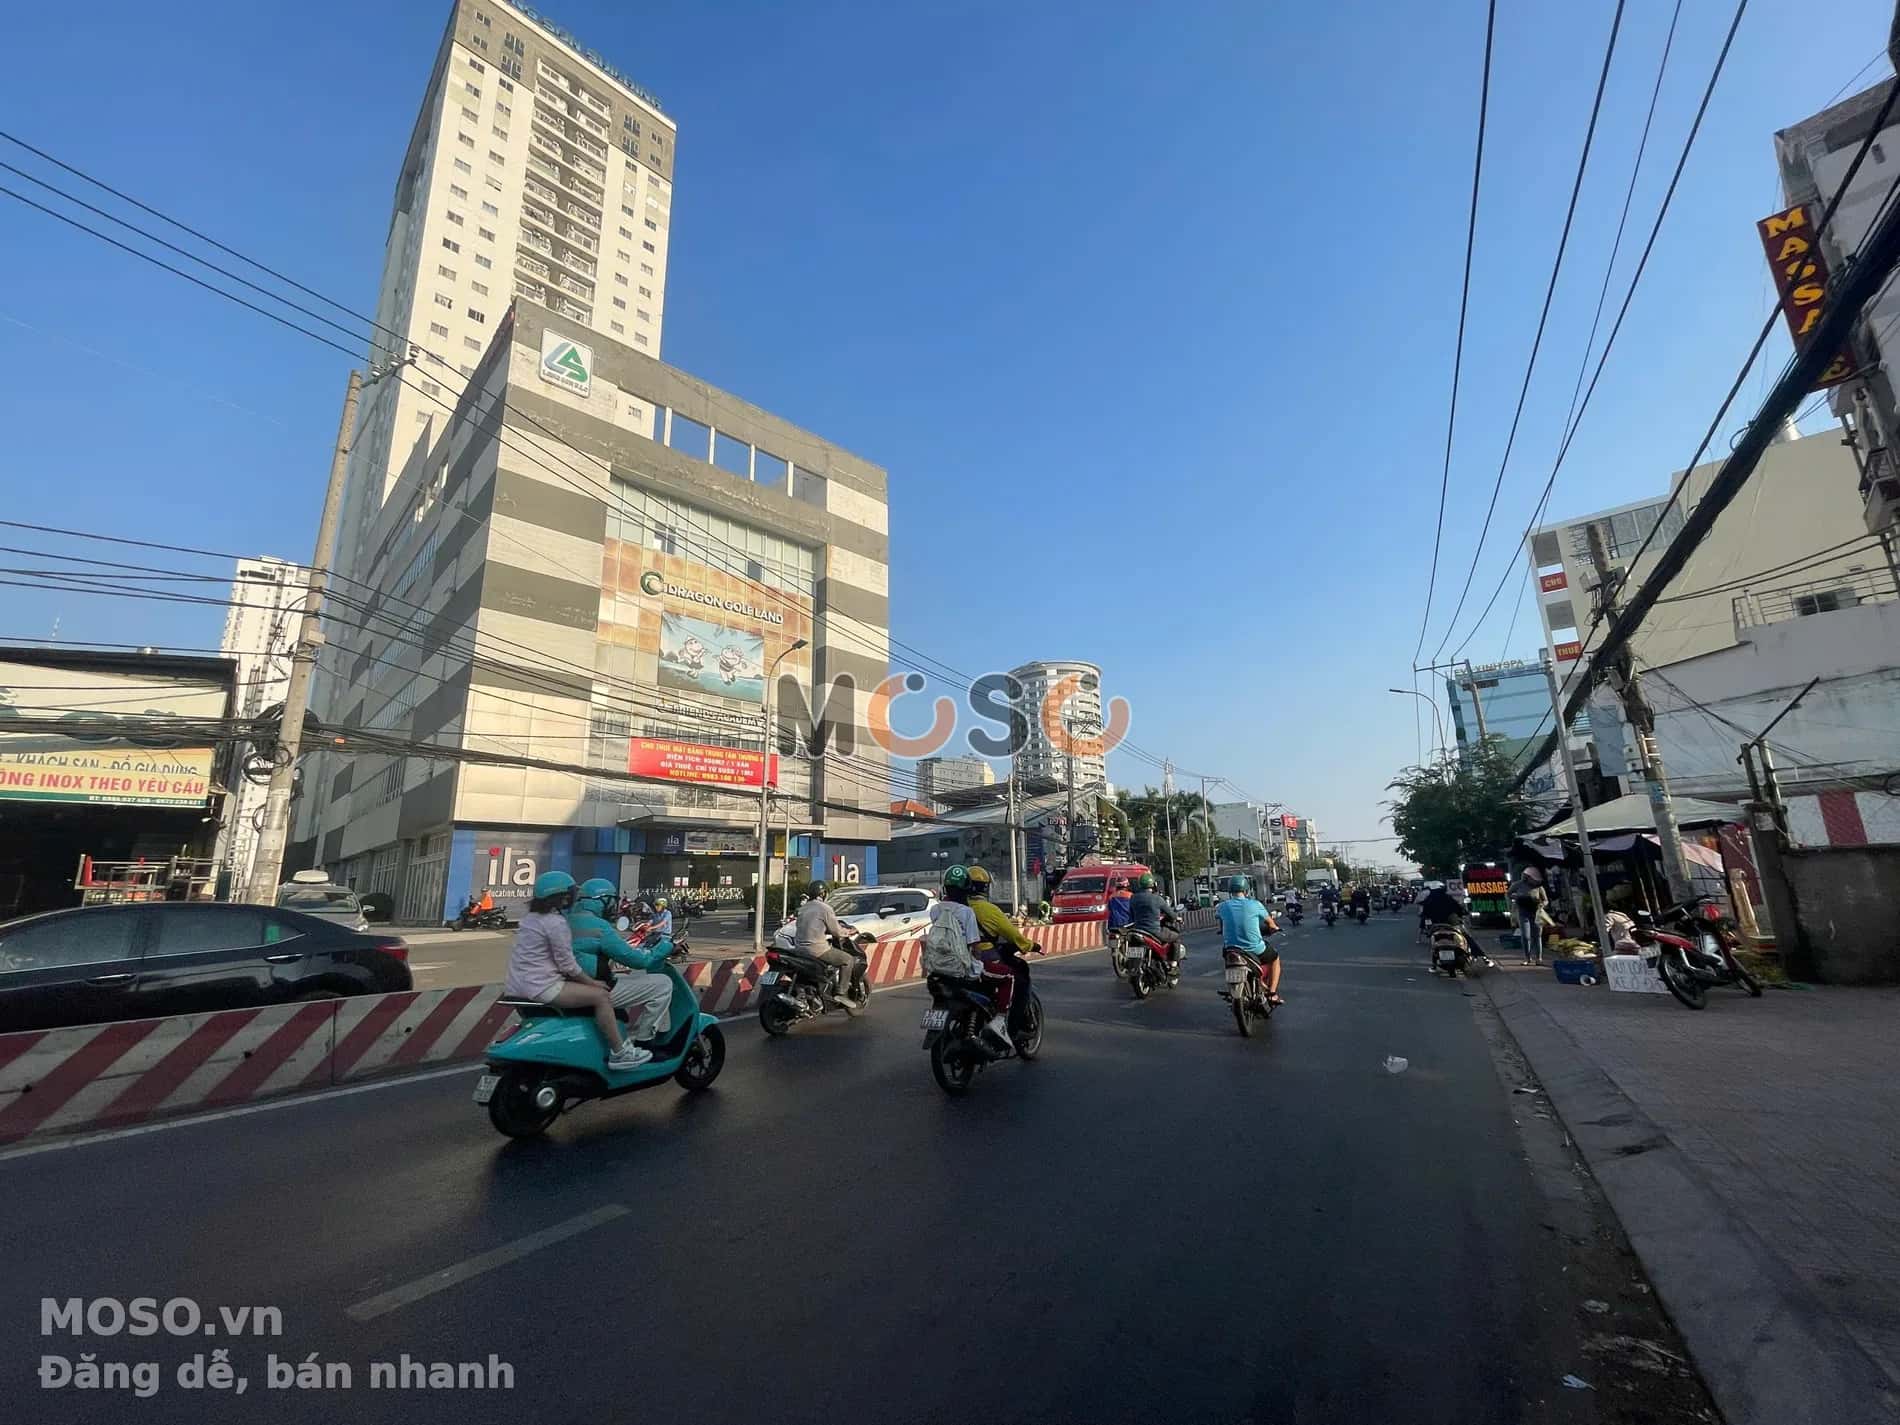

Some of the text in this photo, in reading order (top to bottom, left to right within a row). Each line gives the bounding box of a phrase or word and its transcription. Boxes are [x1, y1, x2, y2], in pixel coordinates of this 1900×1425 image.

[668, 583, 722, 608] DRAGON
[754, 607, 784, 625] LAND
[40, 773, 84, 789] INOX
[89, 775, 132, 791] THEO
[488, 846, 537, 886] ila
[832, 855, 859, 883] ila
[1467, 881, 1509, 895] MASSAGE
